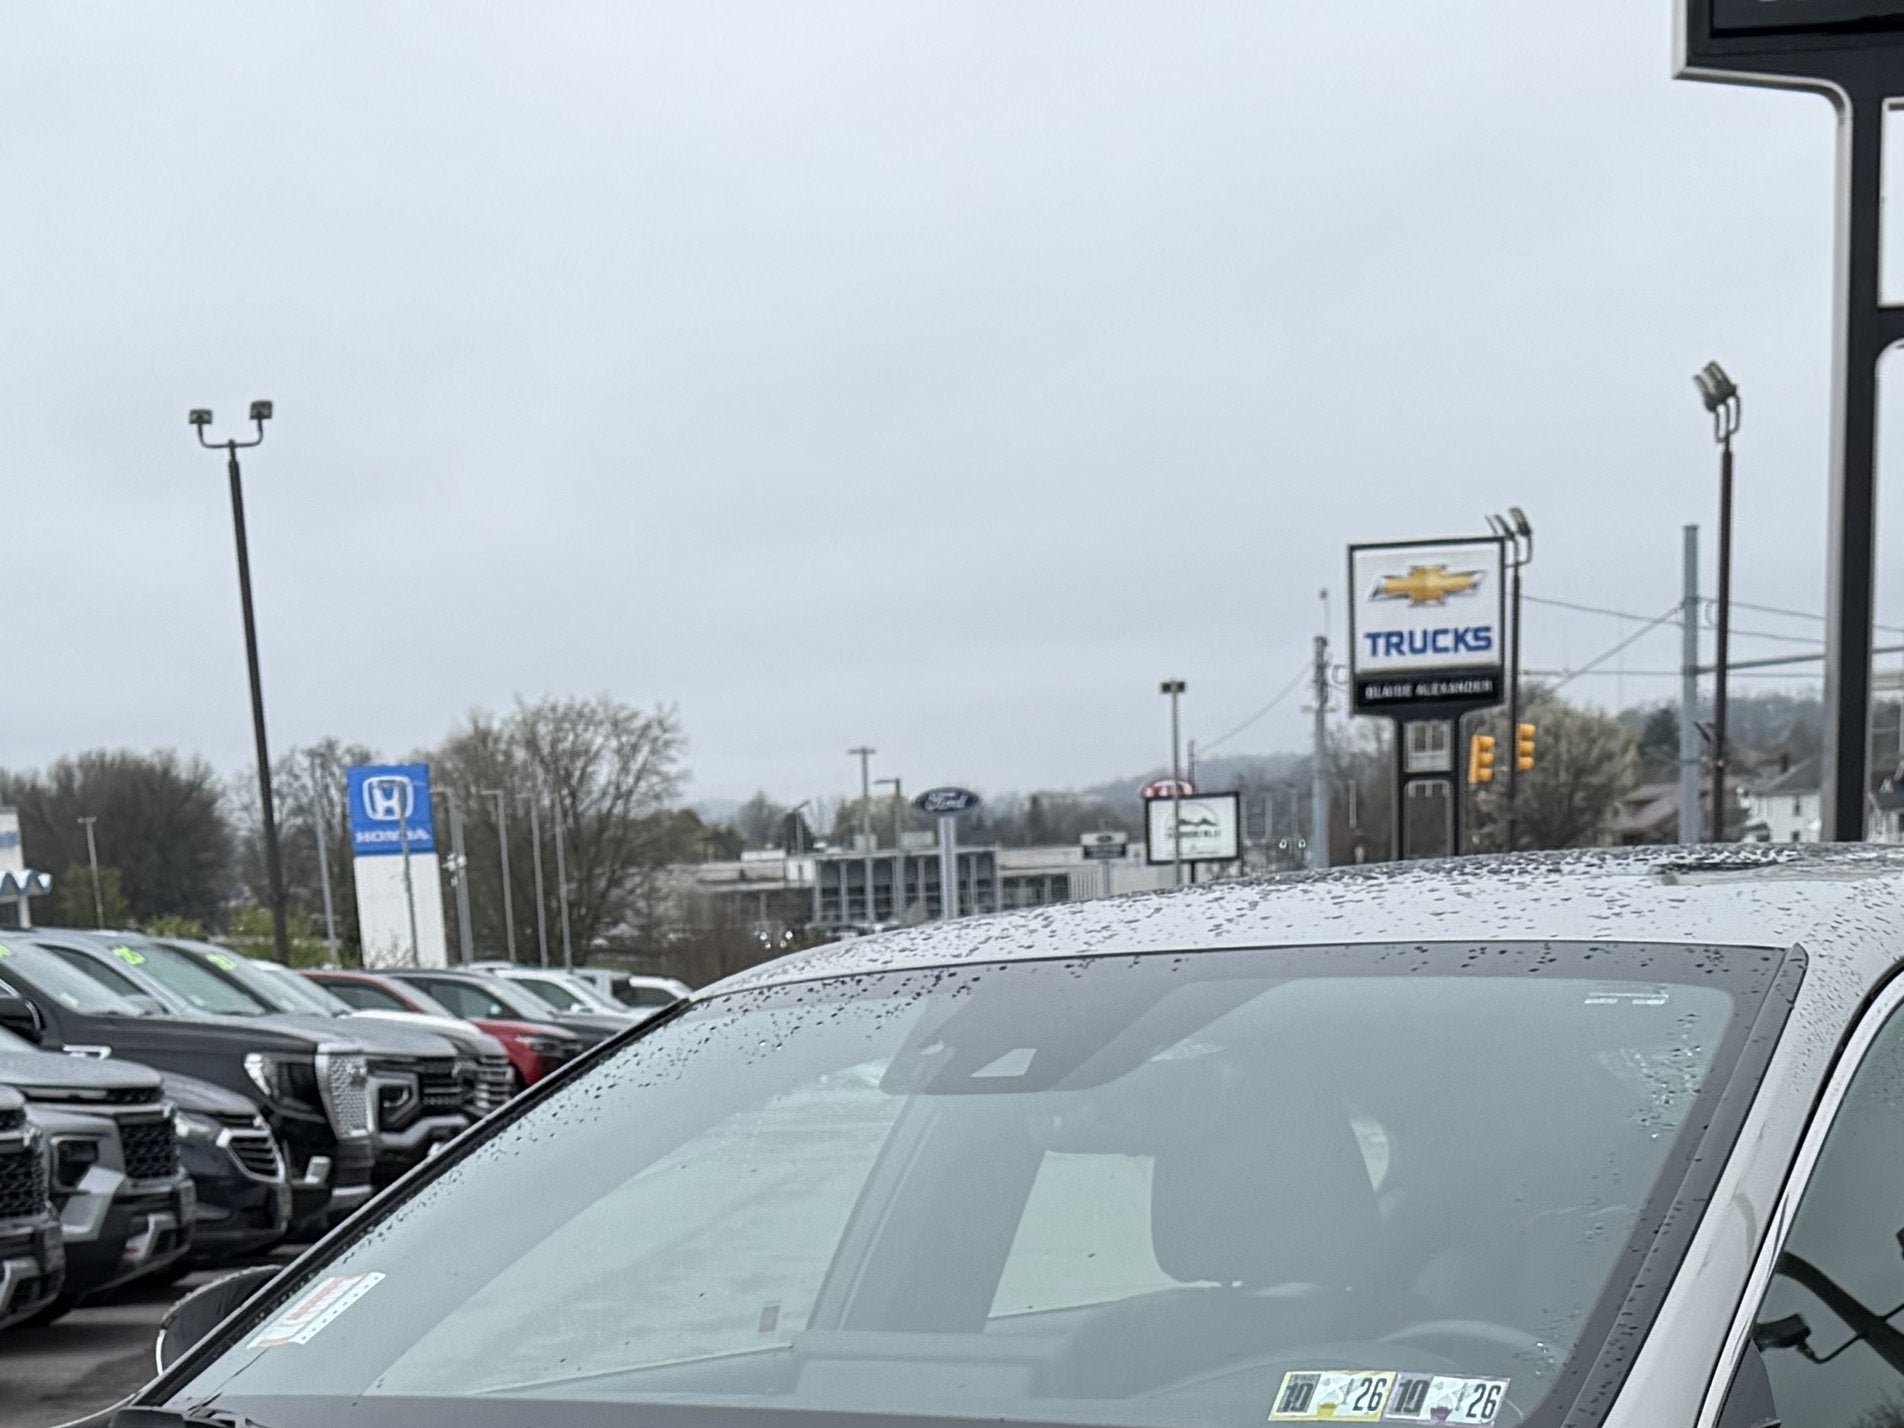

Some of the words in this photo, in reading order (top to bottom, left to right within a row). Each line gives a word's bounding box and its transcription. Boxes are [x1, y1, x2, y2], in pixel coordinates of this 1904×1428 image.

[1365, 626, 1492, 656] TRUCKS
[1352, 1377, 1387, 1412] 26
[1465, 1384, 1502, 1419] 26
